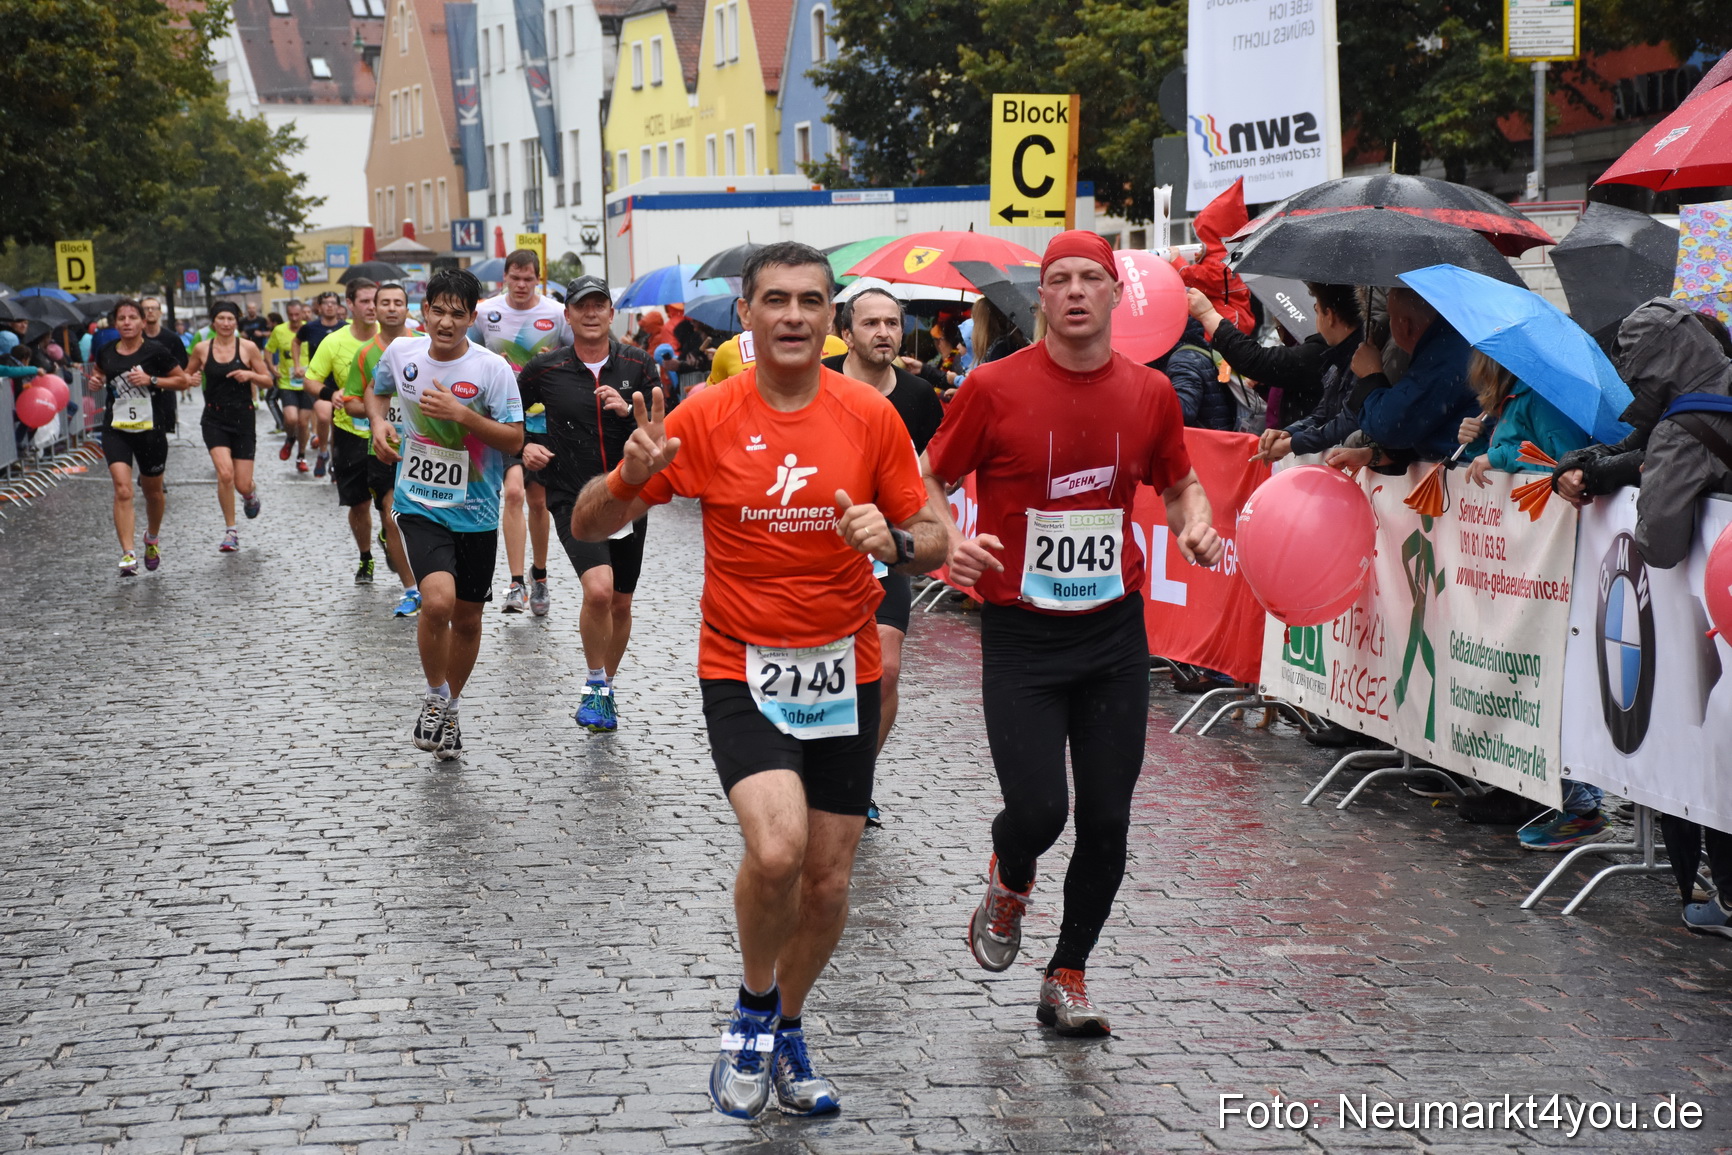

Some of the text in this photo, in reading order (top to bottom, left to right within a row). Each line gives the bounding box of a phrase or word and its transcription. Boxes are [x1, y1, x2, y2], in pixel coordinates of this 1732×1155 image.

[1003, 100, 1068, 124] Block
[1012, 134, 1056, 199] C
[60, 243, 89, 254] Block
[66, 256, 86, 283] D
[1121, 255, 1149, 317] RÖDL
[128, 406, 137, 421] 5
[745, 443, 767, 452] erima
[407, 455, 463, 487] 2820
[1068, 475, 1097, 490] DEHN
[409, 484, 431, 498] Amir
[431, 485, 454, 501] Reza
[740, 505, 836, 523] funrunners
[768, 516, 841, 533] neumark
[1069, 513, 1116, 527] BOCK
[1458, 497, 1504, 528] Service-Line:
[1033, 520, 1065, 530] NeuerMarkt
[1035, 534, 1116, 574] 2043
[1052, 582, 1098, 598] Robert
[1450, 629, 1541, 689] Gebäudereinigung
[760, 658, 845, 697] 2145
[1450, 676, 1541, 729] Hausmeisterdienst
[1451, 723, 1547, 782] Arbeitsbühnenverleih
